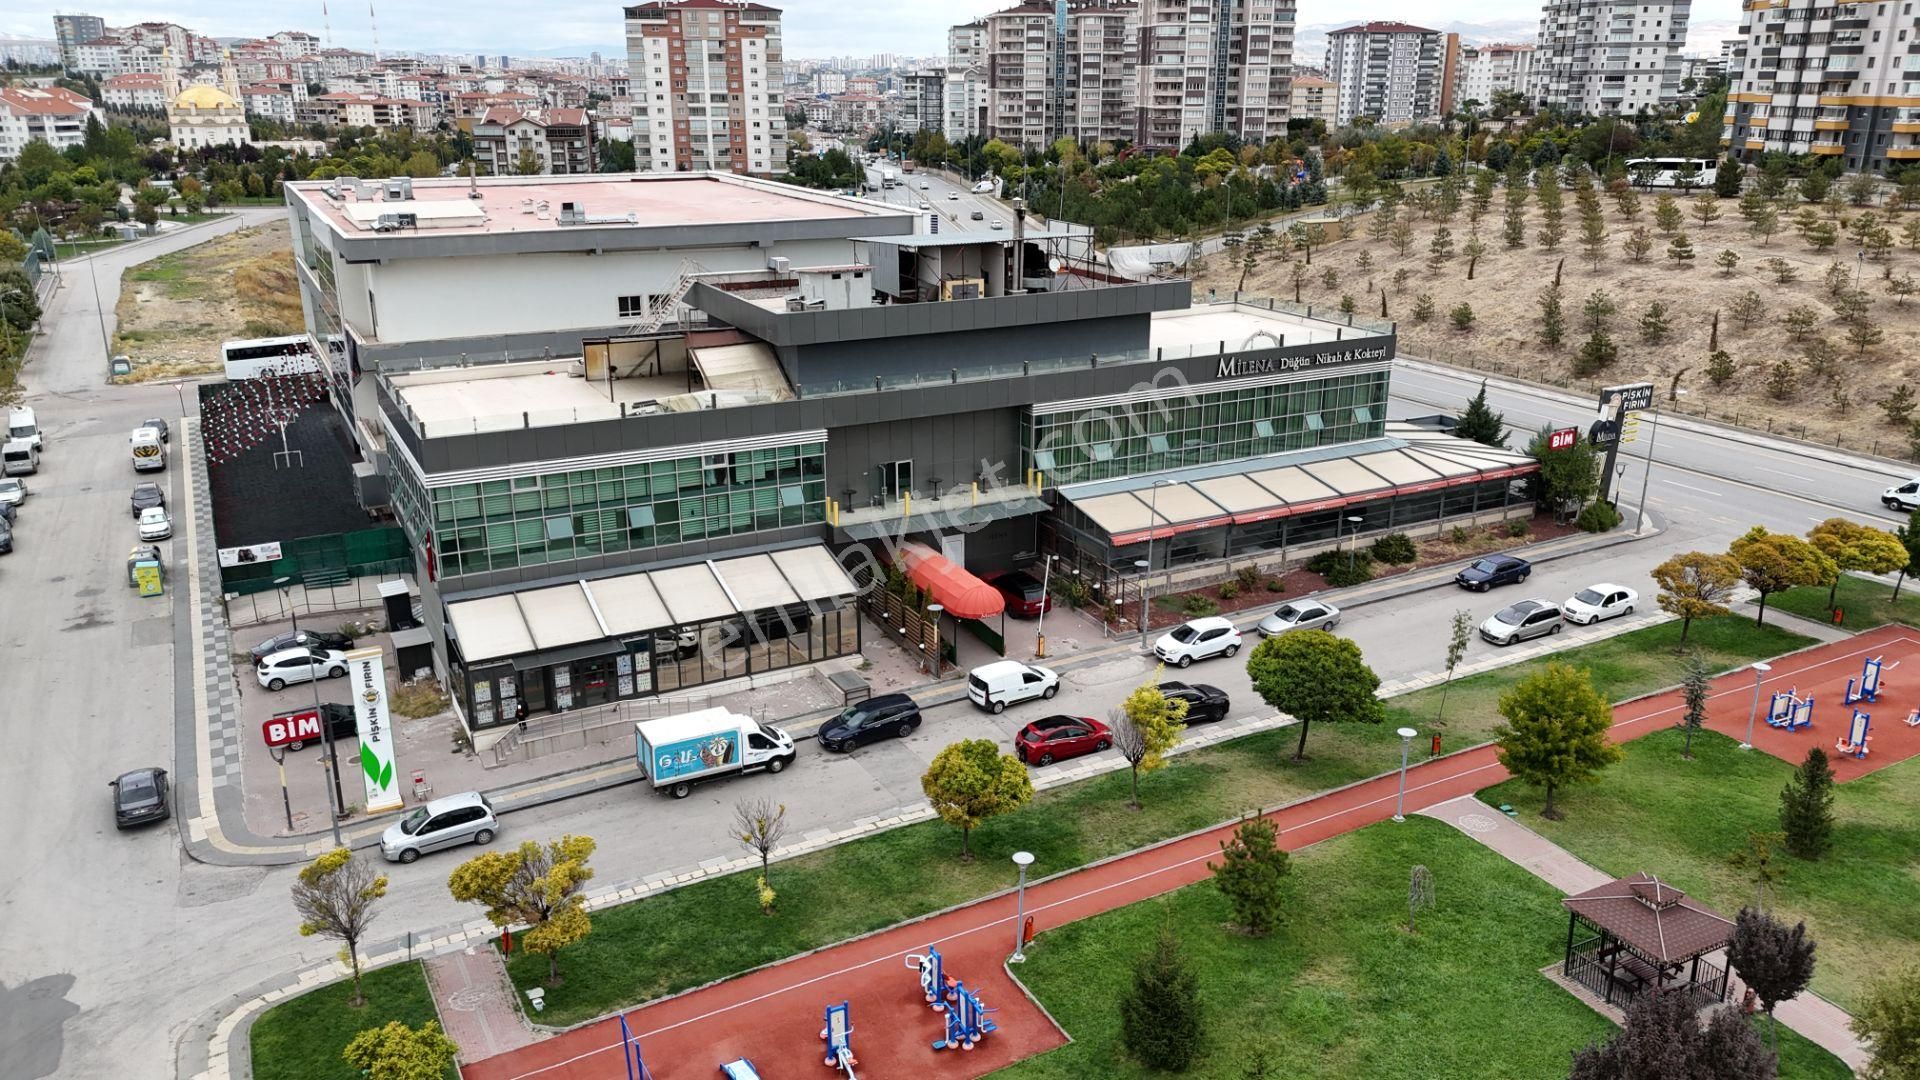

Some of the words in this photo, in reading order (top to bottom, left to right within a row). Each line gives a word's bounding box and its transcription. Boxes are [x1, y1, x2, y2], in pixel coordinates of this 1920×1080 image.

[1280, 356, 1310, 370] Düğün
[1315, 351, 1342, 364] Nikah
[1344, 352, 1352, 361] &
[1353, 346, 1387, 360] Kokteyl
[1623, 398, 1646, 410] FIRIN
[1552, 432, 1573, 448] BİM
[361, 661, 374, 688] FIRIN
[268, 716, 320, 742] BİM
[367, 707, 382, 743] PİŞKİN
